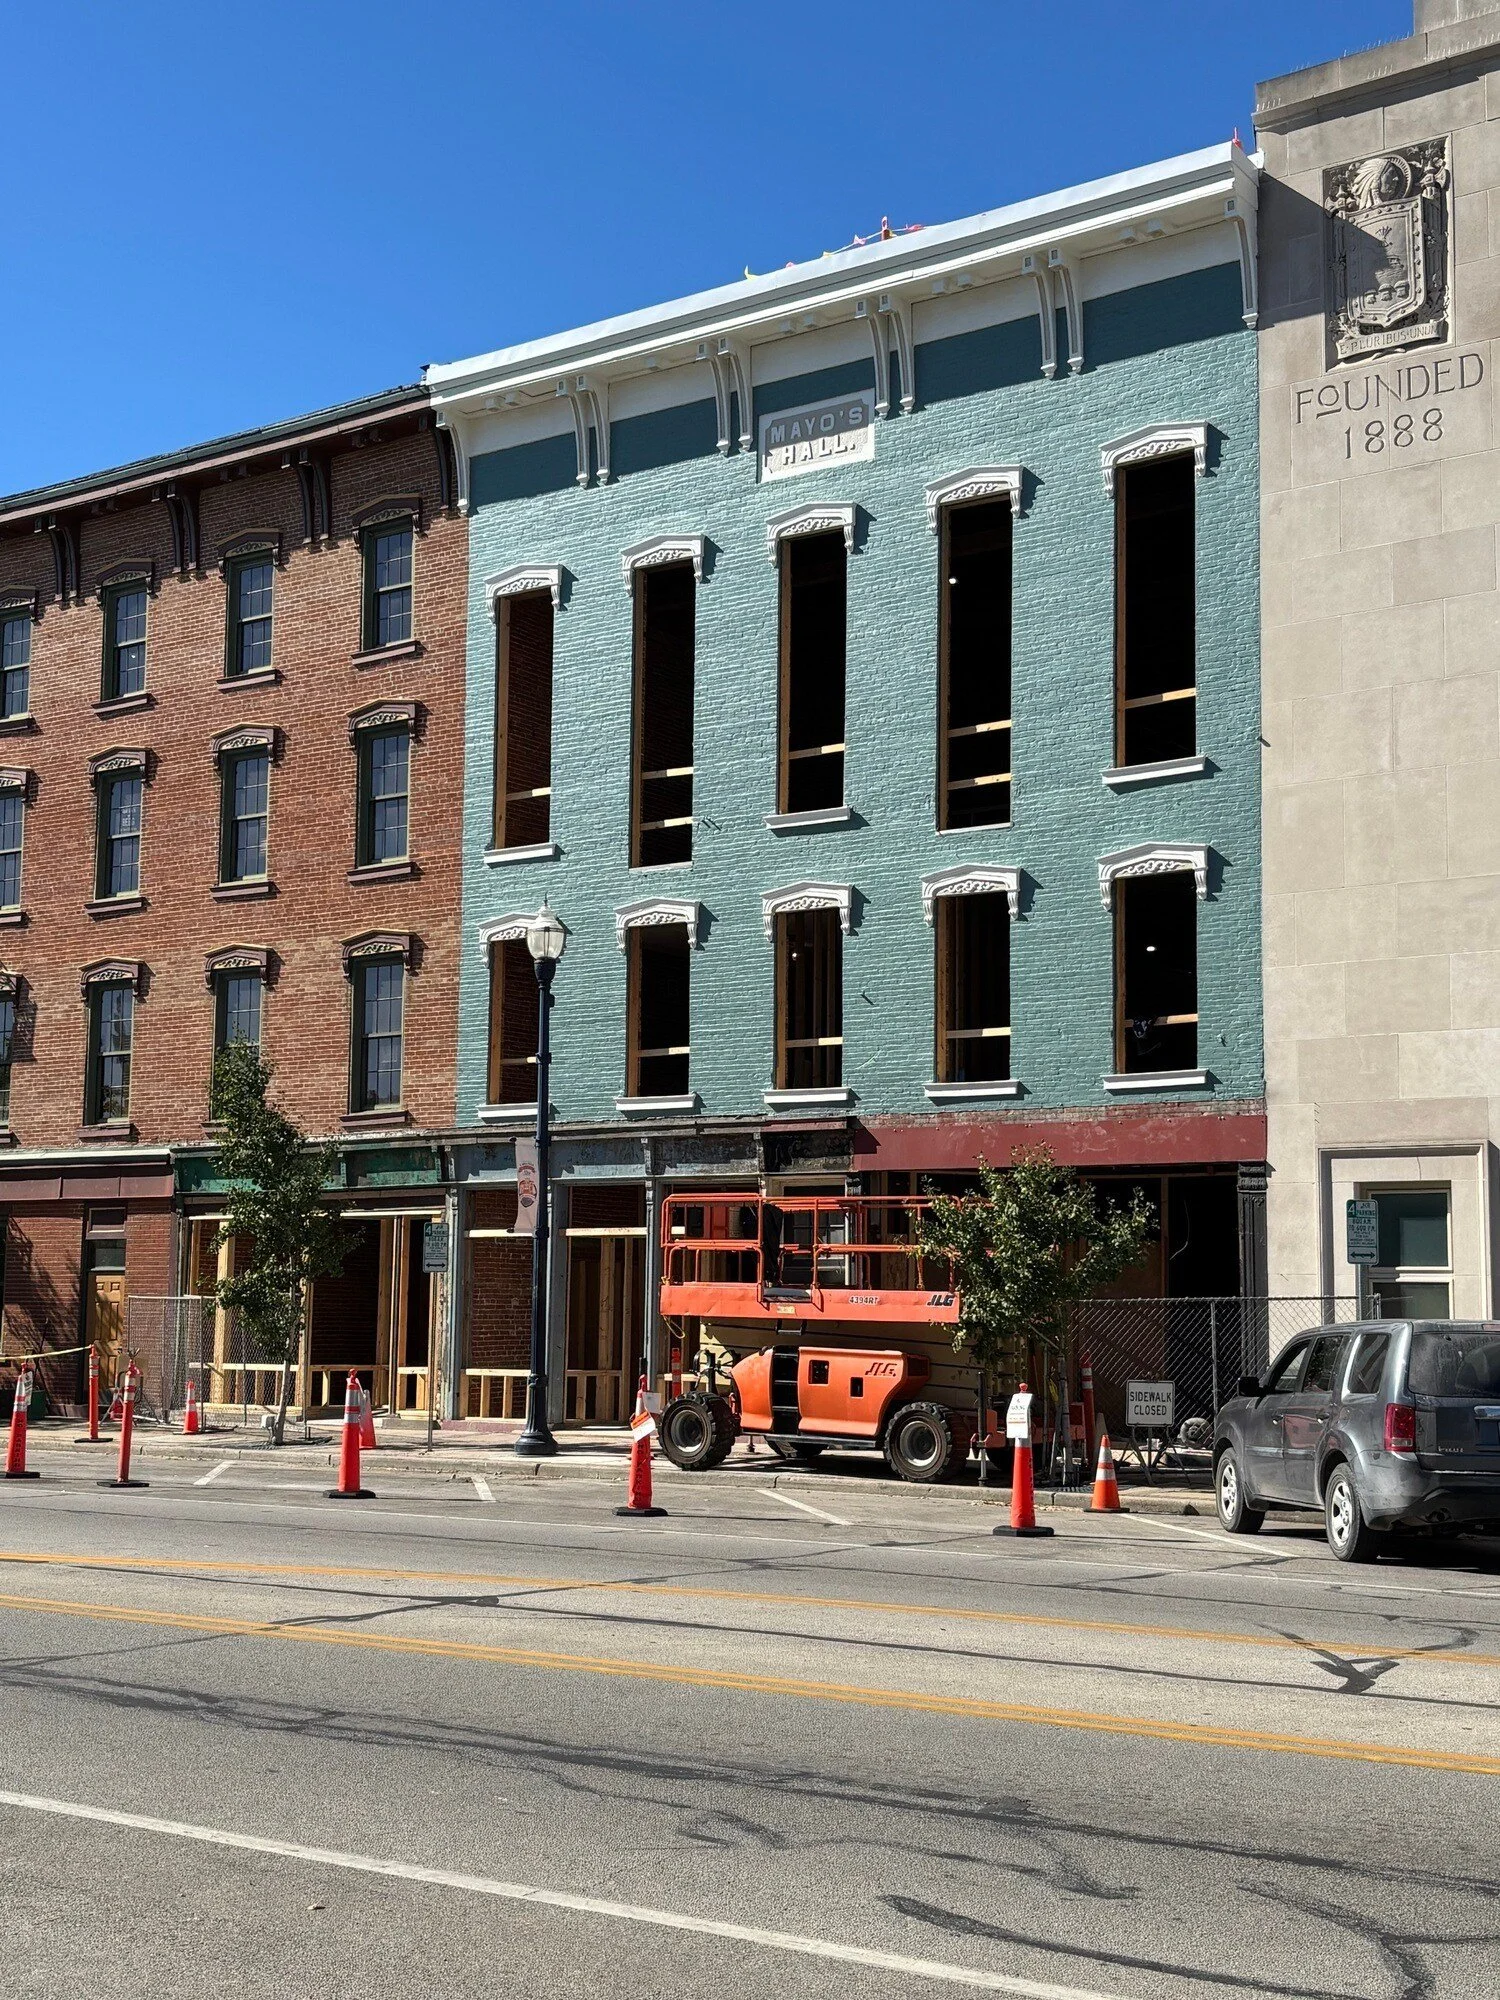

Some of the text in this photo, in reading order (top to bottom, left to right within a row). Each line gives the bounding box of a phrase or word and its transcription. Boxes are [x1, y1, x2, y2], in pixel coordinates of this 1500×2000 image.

[1295, 353, 1484, 424] FOUNDED
[770, 406, 863, 444] MAYO'S
[1344, 407, 1443, 459] 1888
[927, 1295, 954, 1306] JLG
[1130, 1391, 1172, 1403] SIDEWALK
[1134, 1405, 1167, 1416] CLOSED
